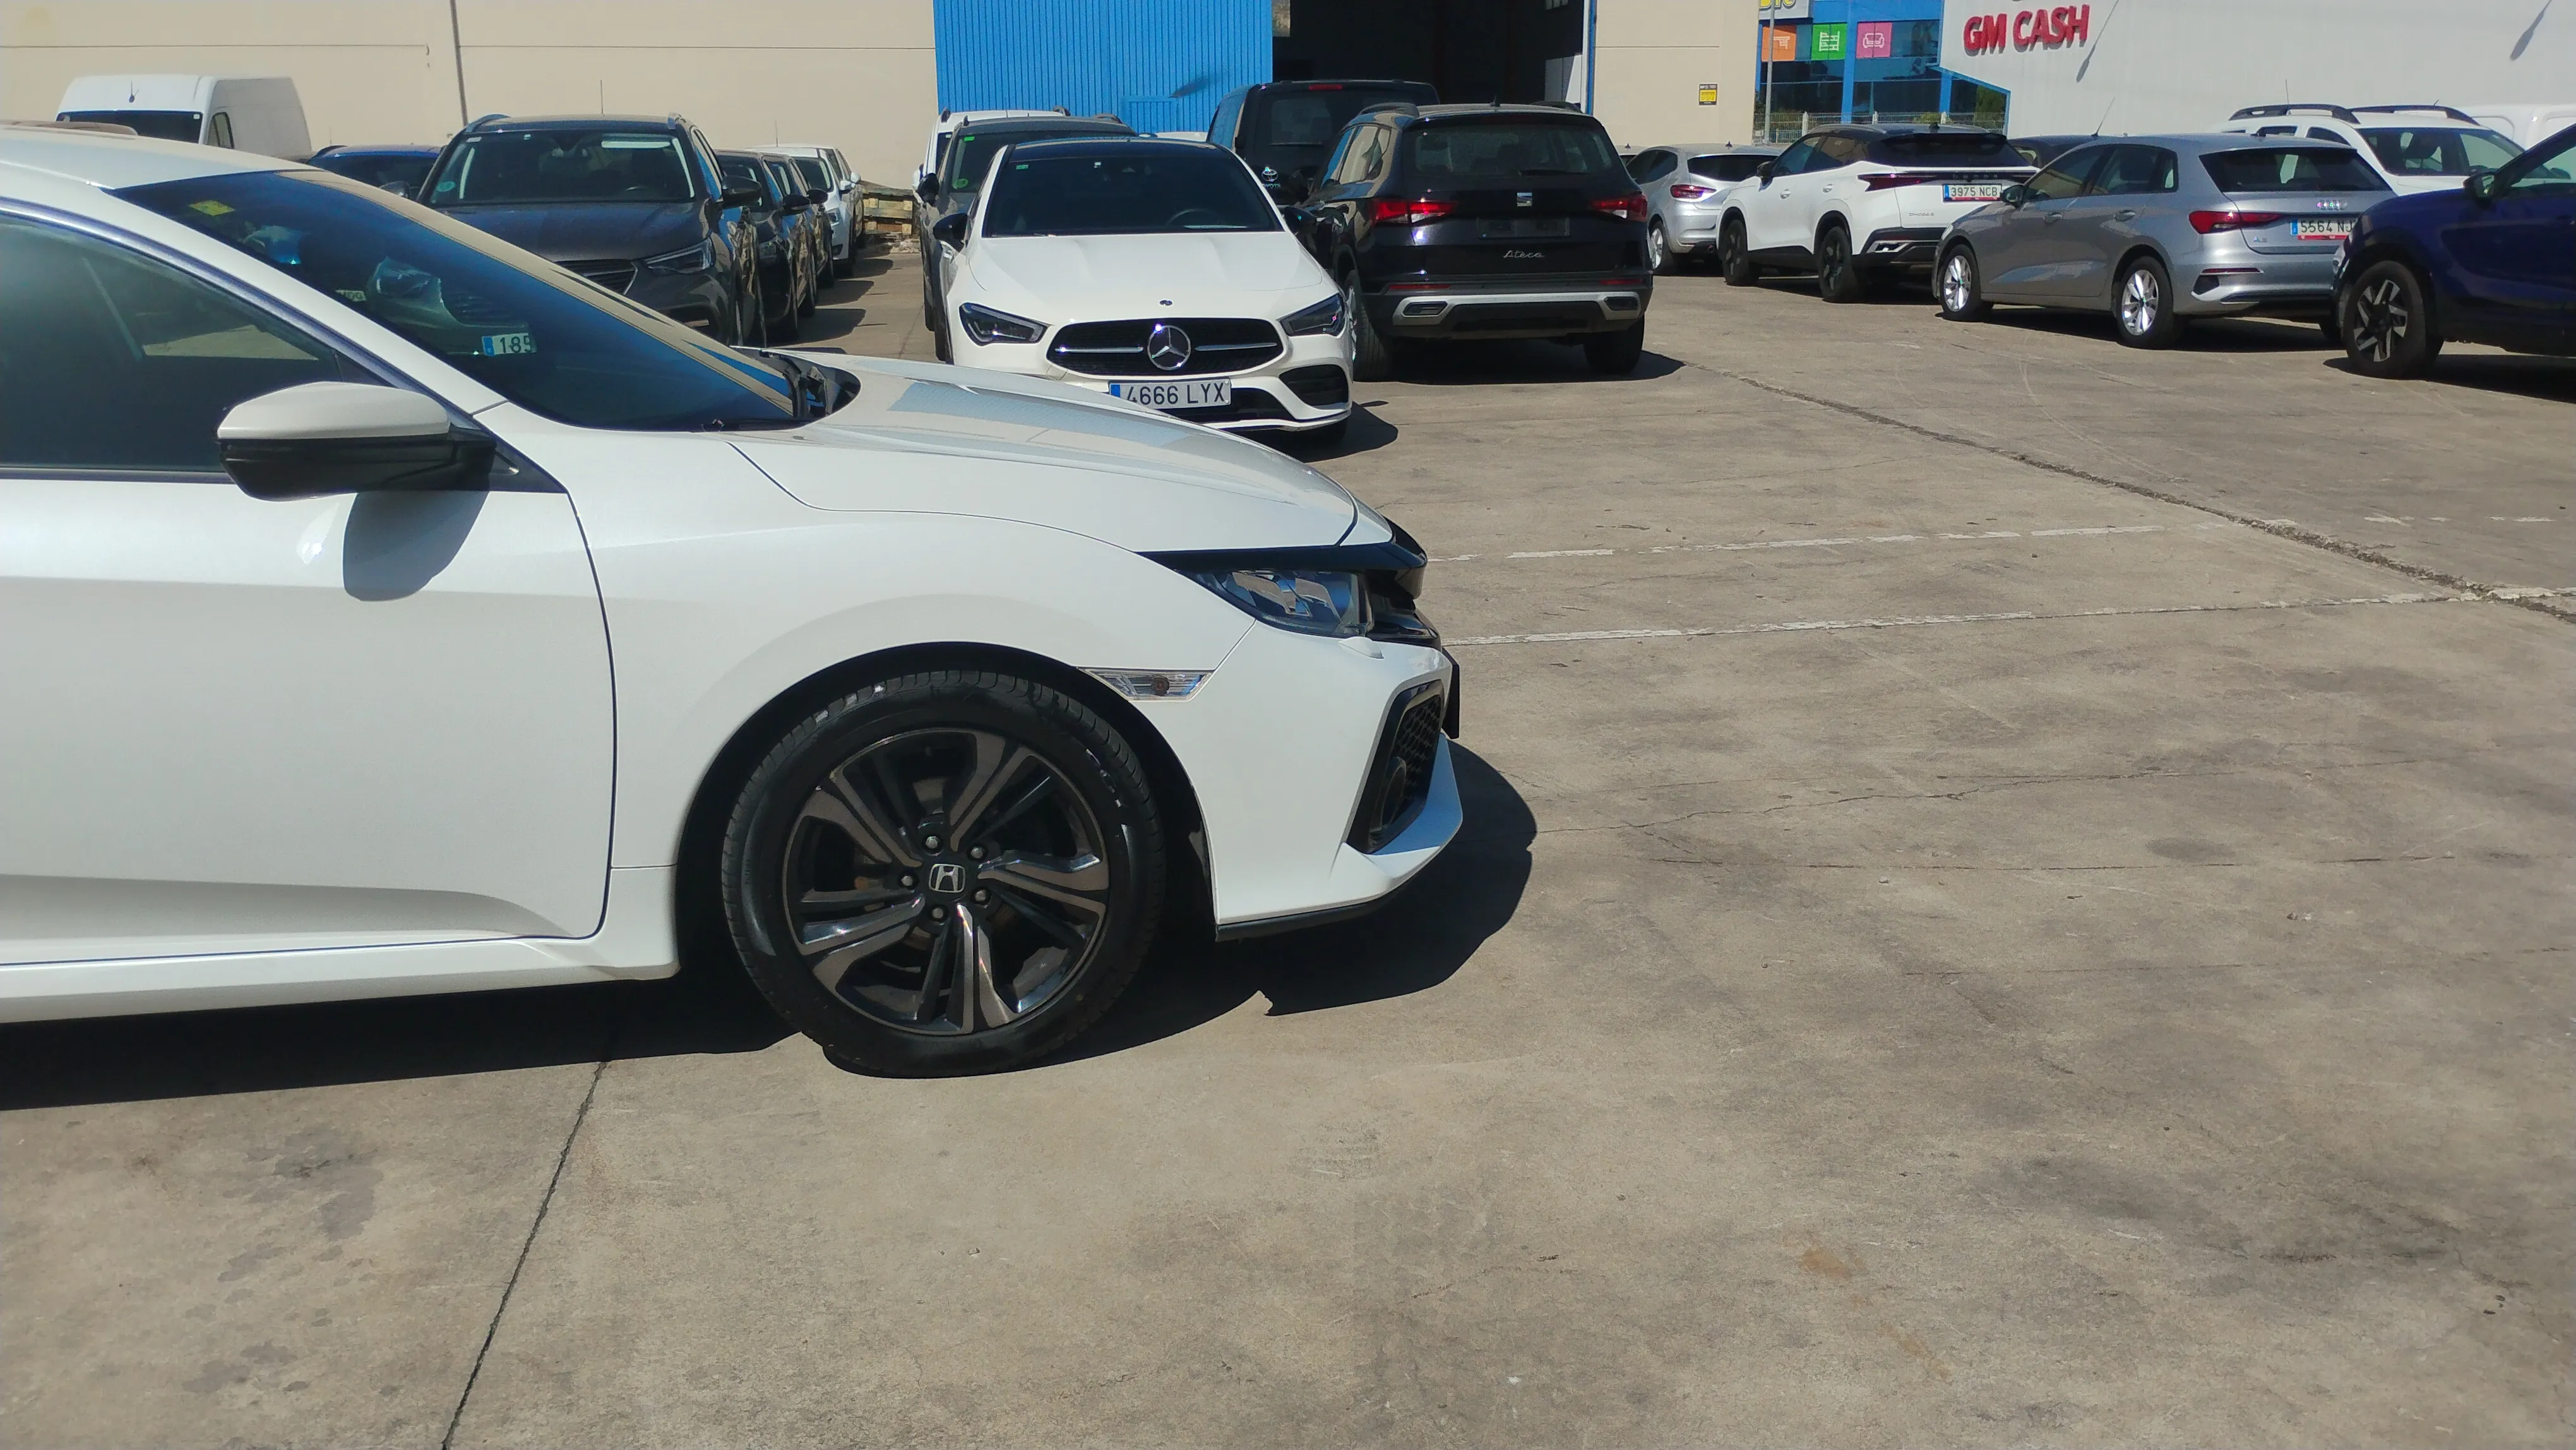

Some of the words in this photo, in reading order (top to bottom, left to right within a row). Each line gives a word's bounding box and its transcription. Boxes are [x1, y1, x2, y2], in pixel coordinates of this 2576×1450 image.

[1964, 13, 2008, 52] GM
[2013, 4, 2090, 47] CASH
[1951, 187, 1976, 197] 3975
[1979, 187, 1998, 197] NCB
[2300, 219, 2333, 233] 5564
[1503, 250, 1545, 258] Ateca
[1126, 385, 1179, 405] 4666
[1186, 381, 1225, 404] LYX
